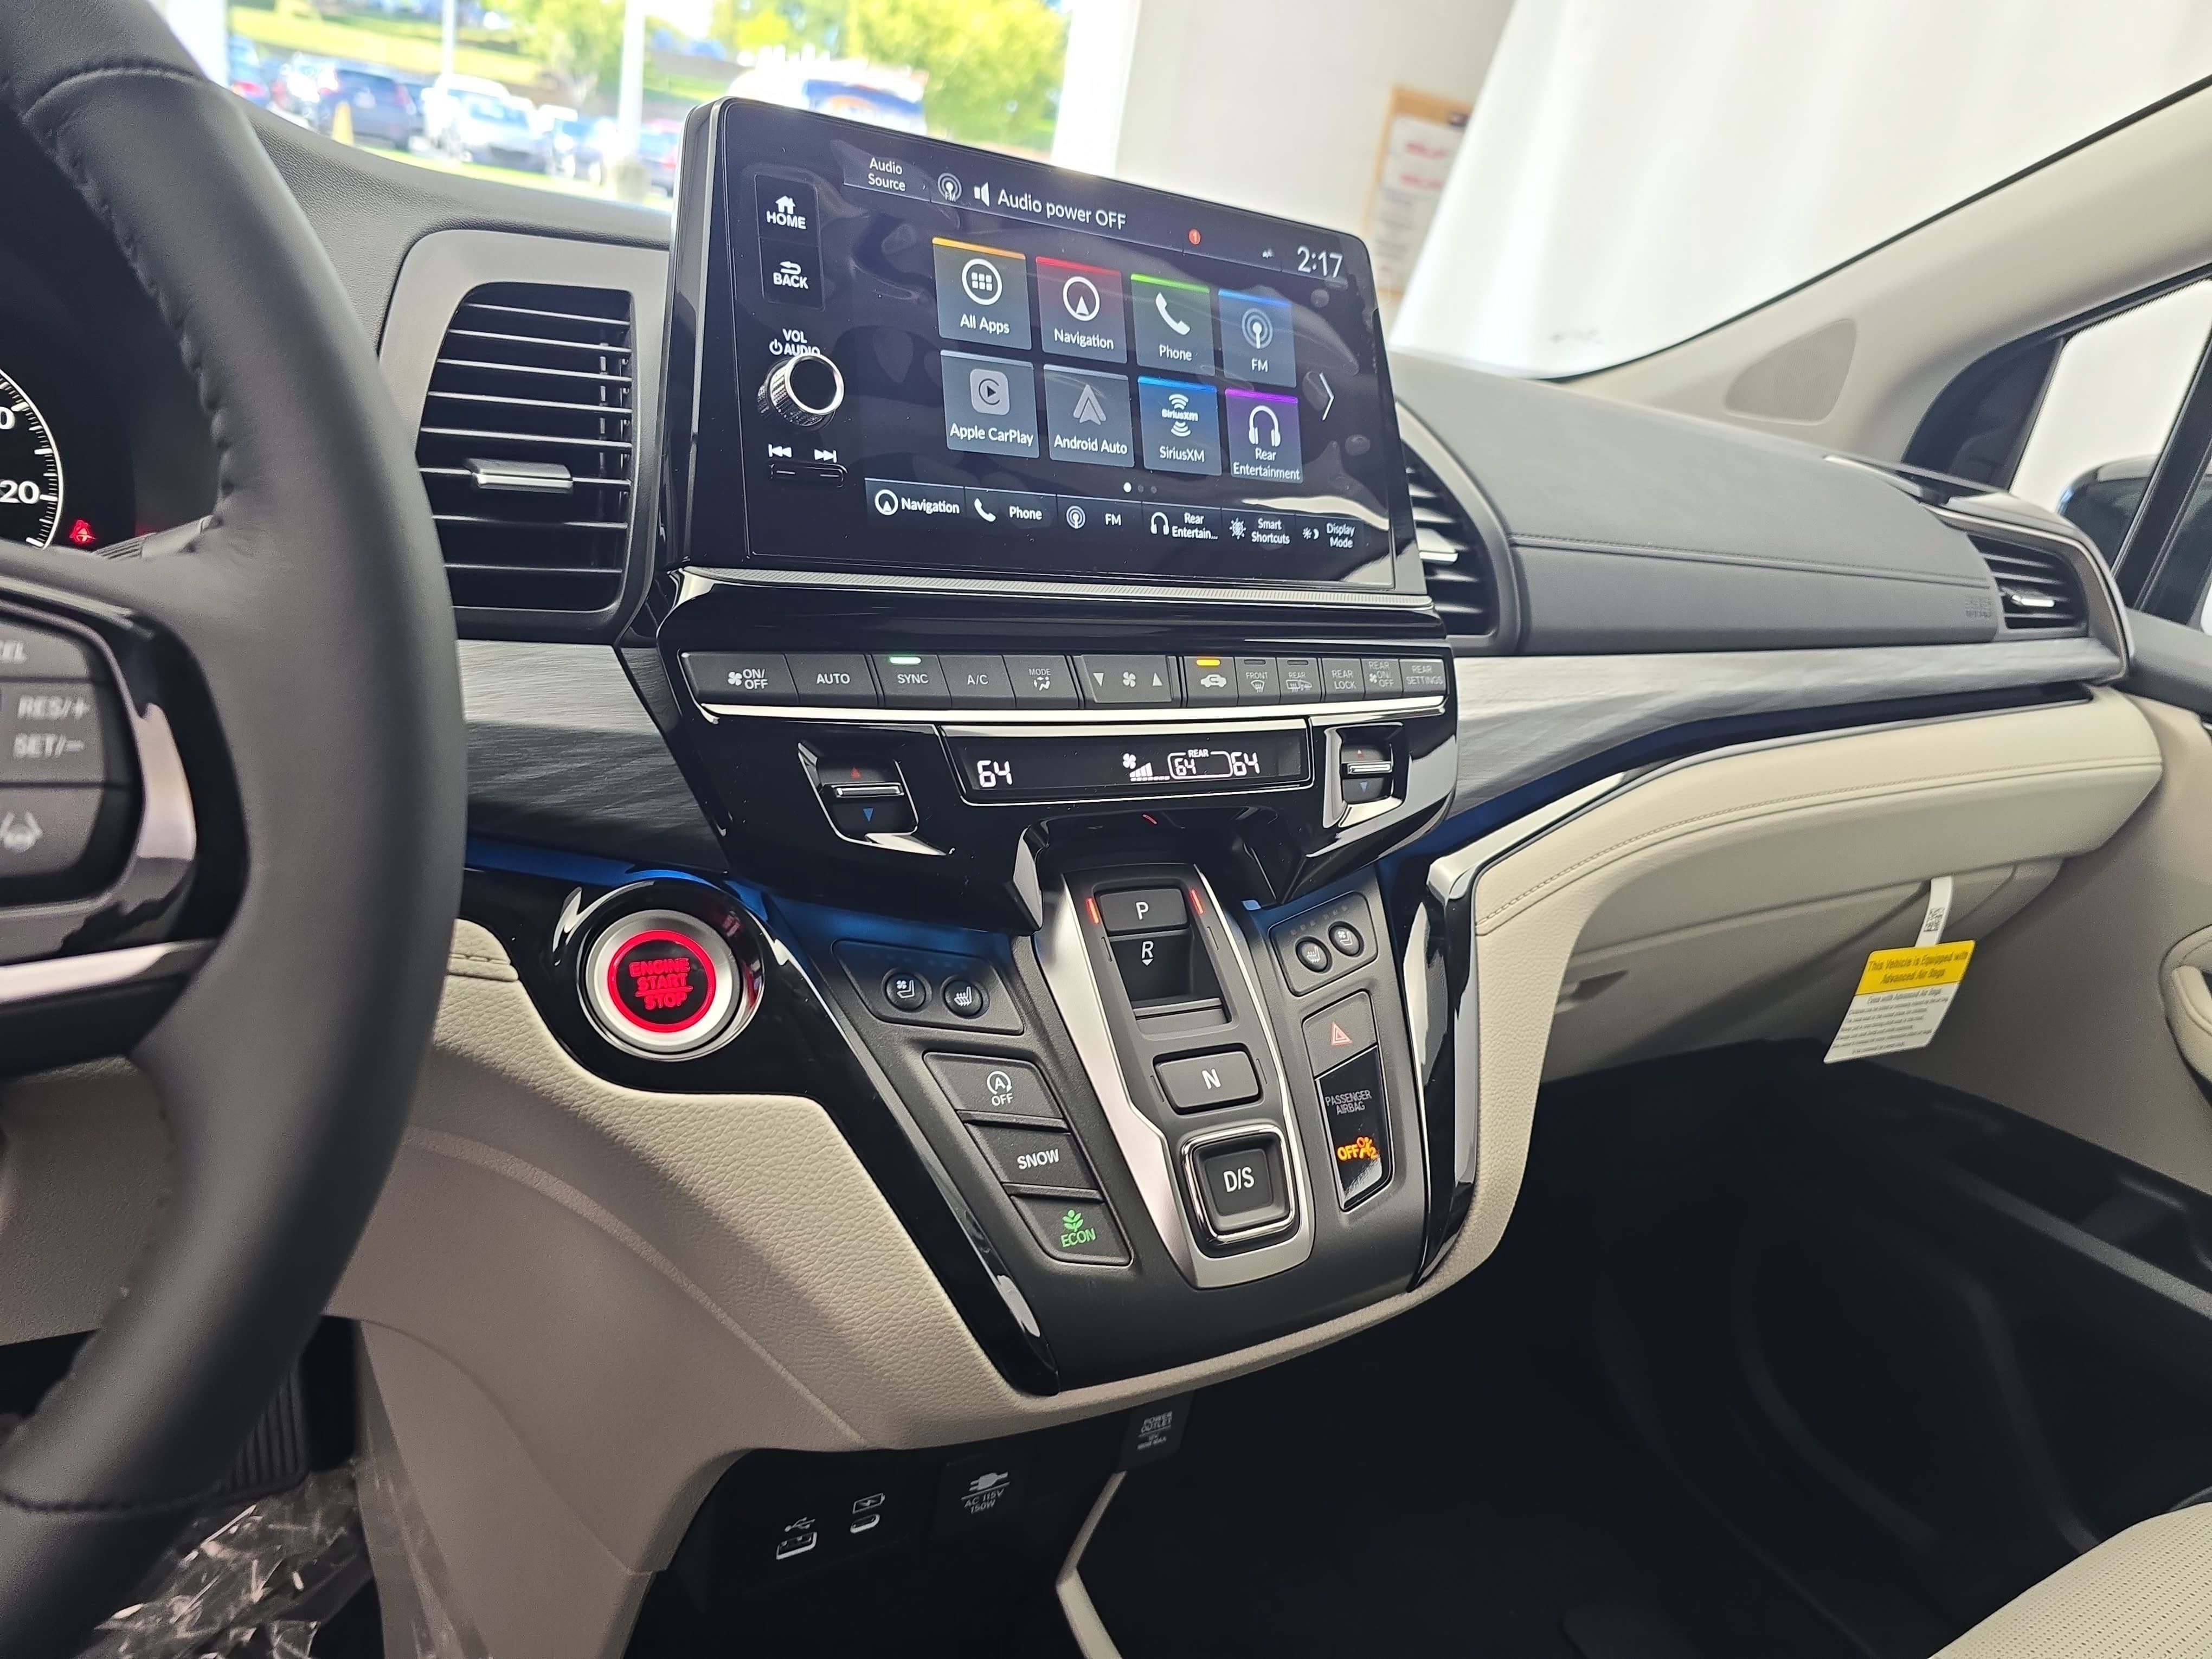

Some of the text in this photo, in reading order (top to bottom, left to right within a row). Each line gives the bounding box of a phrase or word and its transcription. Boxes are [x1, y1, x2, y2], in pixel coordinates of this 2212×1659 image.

[869, 157, 903, 175] Audio
[867, 173, 906, 192] Source
[944, 192, 956, 202] FM
[998, 189, 1127, 230] Audio power OFF
[767, 211, 807, 230] HOME
[1297, 245, 1343, 278] 2:17
[773, 272, 809, 290] BACK
[960, 313, 1010, 335] All Apps
[782, 329, 808, 344] VOL
[1053, 328, 1114, 350] Navigation
[784, 343, 821, 356] AUDIO
[1159, 344, 1192, 361] Phone
[1251, 358, 1268, 372] FM
[949, 423, 1034, 447] Apple CarPlay
[1053, 434, 1128, 455] Android Auto
[1159, 446, 1205, 463] SiriusXM
[1255, 447, 1277, 461] Rear
[1233, 462, 1301, 481] Entertainment
[0, 479, 40, 504] 20
[901, 497, 960, 514] Navigation
[1009, 505, 1043, 520] Phone
[1105, 513, 1122, 526] FM
[1184, 512, 1205, 525] Rear
[1257, 518, 1282, 531] Smart
[1172, 525, 1219, 541] Entertain...
[1251, 531, 1290, 545] Shortcuts
[1326, 523, 1355, 537] Display
[1329, 536, 1354, 549] Mode
[742, 668, 765, 679] ON/
[1029, 668, 1051, 677] MODE
[1368, 661, 1390, 670] REAR
[1411, 665, 1432, 674] REAR
[816, 673, 850, 685] AUTO
[897, 674, 929, 685] SYNC
[967, 674, 989, 686] A/C
[1331, 670, 1354, 679] REAR
[1405, 676, 1444, 685] SETTINGS
[744, 678, 768, 690] OFF
[1334, 680, 1356, 690] LOCK
[1378, 679, 1394, 687] OFF
[1187, 749, 1210, 758] REAR
[1174, 757, 1197, 776] 64
[1231, 751, 1261, 776] 64
[977, 760, 1013, 788] 64
[1135, 901, 1149, 920] P
[1141, 941, 1154, 959] R
[629, 958, 691, 977] ENGINE
[1868, 960, 1884, 972] This
[1886, 957, 1912, 970] Vehicle
[1912, 957, 1919, 967] is
[1921, 951, 1953, 967] Equipped
[636, 973, 689, 992] START
[1880, 967, 1946, 984] Advanced Air Bags
[644, 992, 687, 1011] STOP
[1201, 1068, 1222, 1090] N
[991, 1092, 1013, 1107] OFF
[1325, 1090, 1372, 1107] PASSENGER
[1336, 1101, 1366, 1115] AIRBAG
[1017, 1148, 1059, 1169] SNOW
[1337, 1144, 1359, 1161] OFF
[1223, 1166, 1255, 1193] D/S
[1060, 1228, 1096, 1248] ECON
[1140, 1418, 1172, 1433] OUTLET
[964, 1496, 979, 1508] AC
[970, 1499, 996, 1514] 150W
